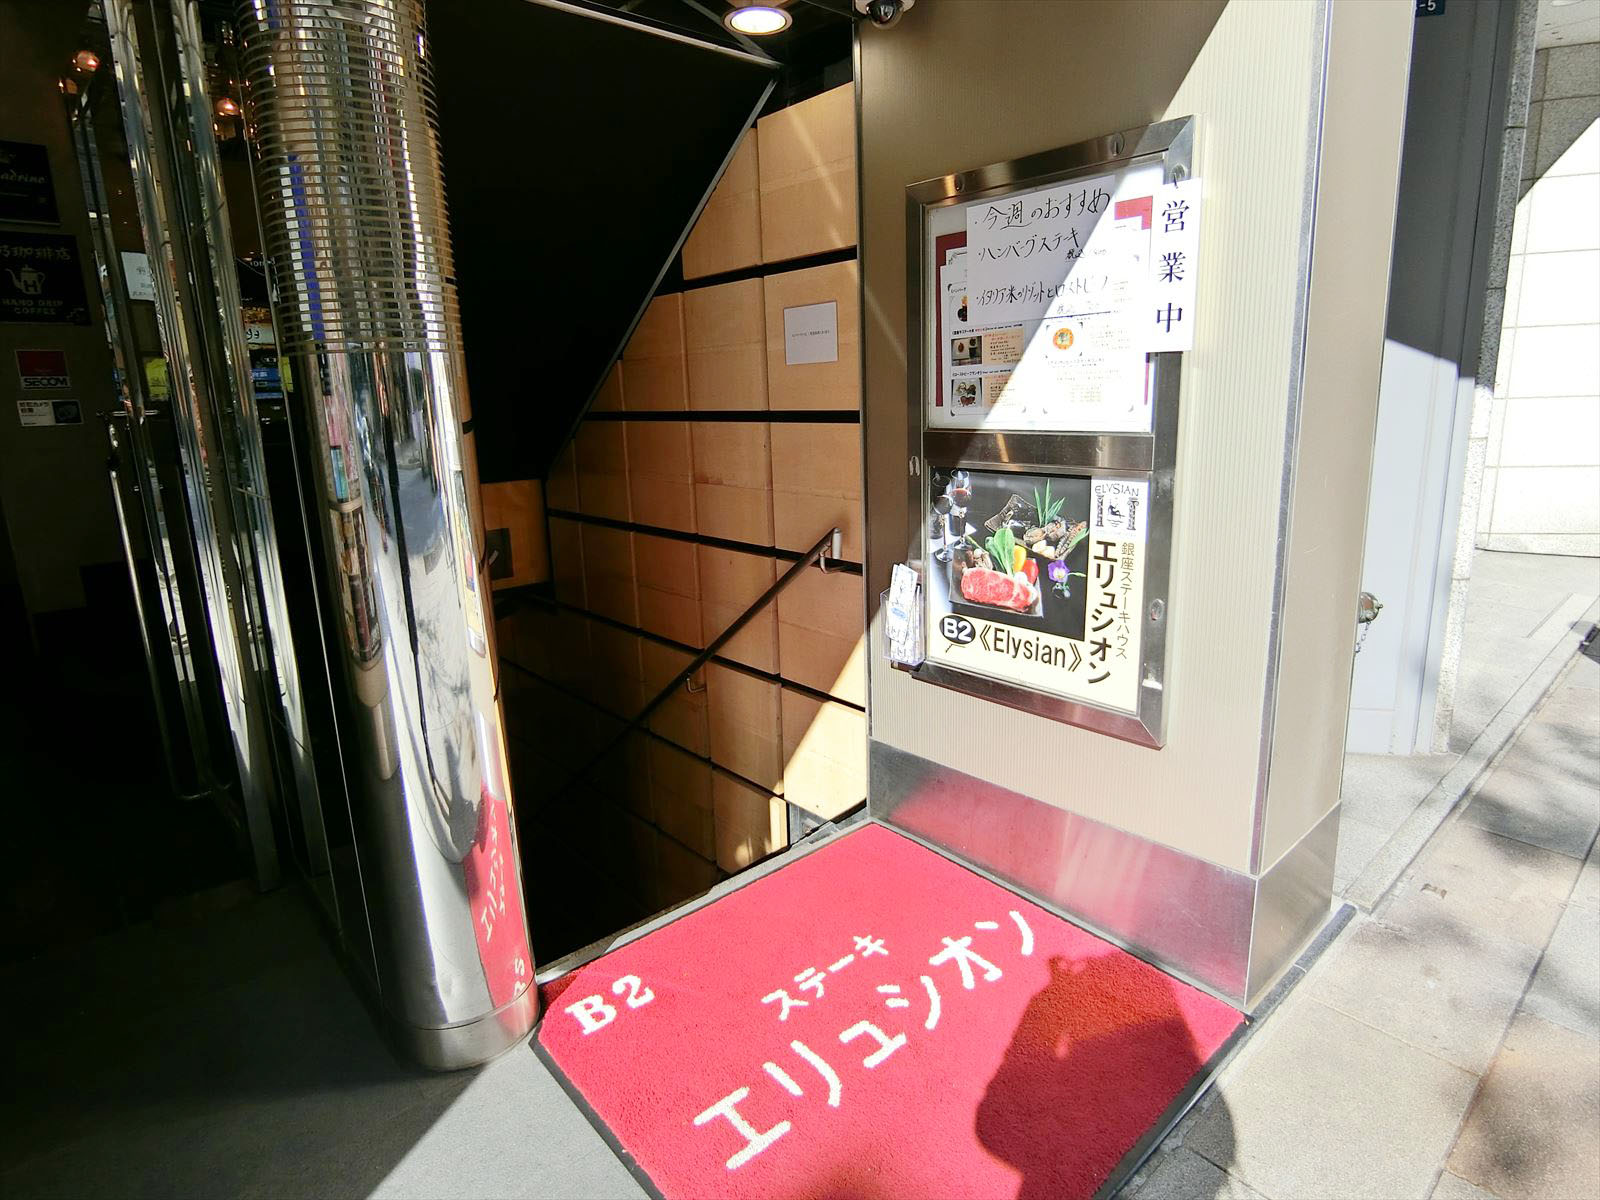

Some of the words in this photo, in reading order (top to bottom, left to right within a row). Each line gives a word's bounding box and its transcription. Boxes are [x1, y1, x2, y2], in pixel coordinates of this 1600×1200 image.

[983, 188, 1111, 230] 今週のおすすめ
[979, 228, 1080, 262] ハンバーグステーキ
[1157, 200, 1189, 333] 営業中
[24, 377, 68, 387] SECOM
[1094, 483, 1140, 497] ELYSIAN
[943, 617, 972, 642] B2
[1088, 540, 1118, 684] エリュシオン
[1115, 542, 1135, 660] 銀座ステーキハウス
[565, 974, 656, 1036] B2
[762, 935, 889, 1022] ステーキ
[694, 910, 1034, 1170] エリュシオン
